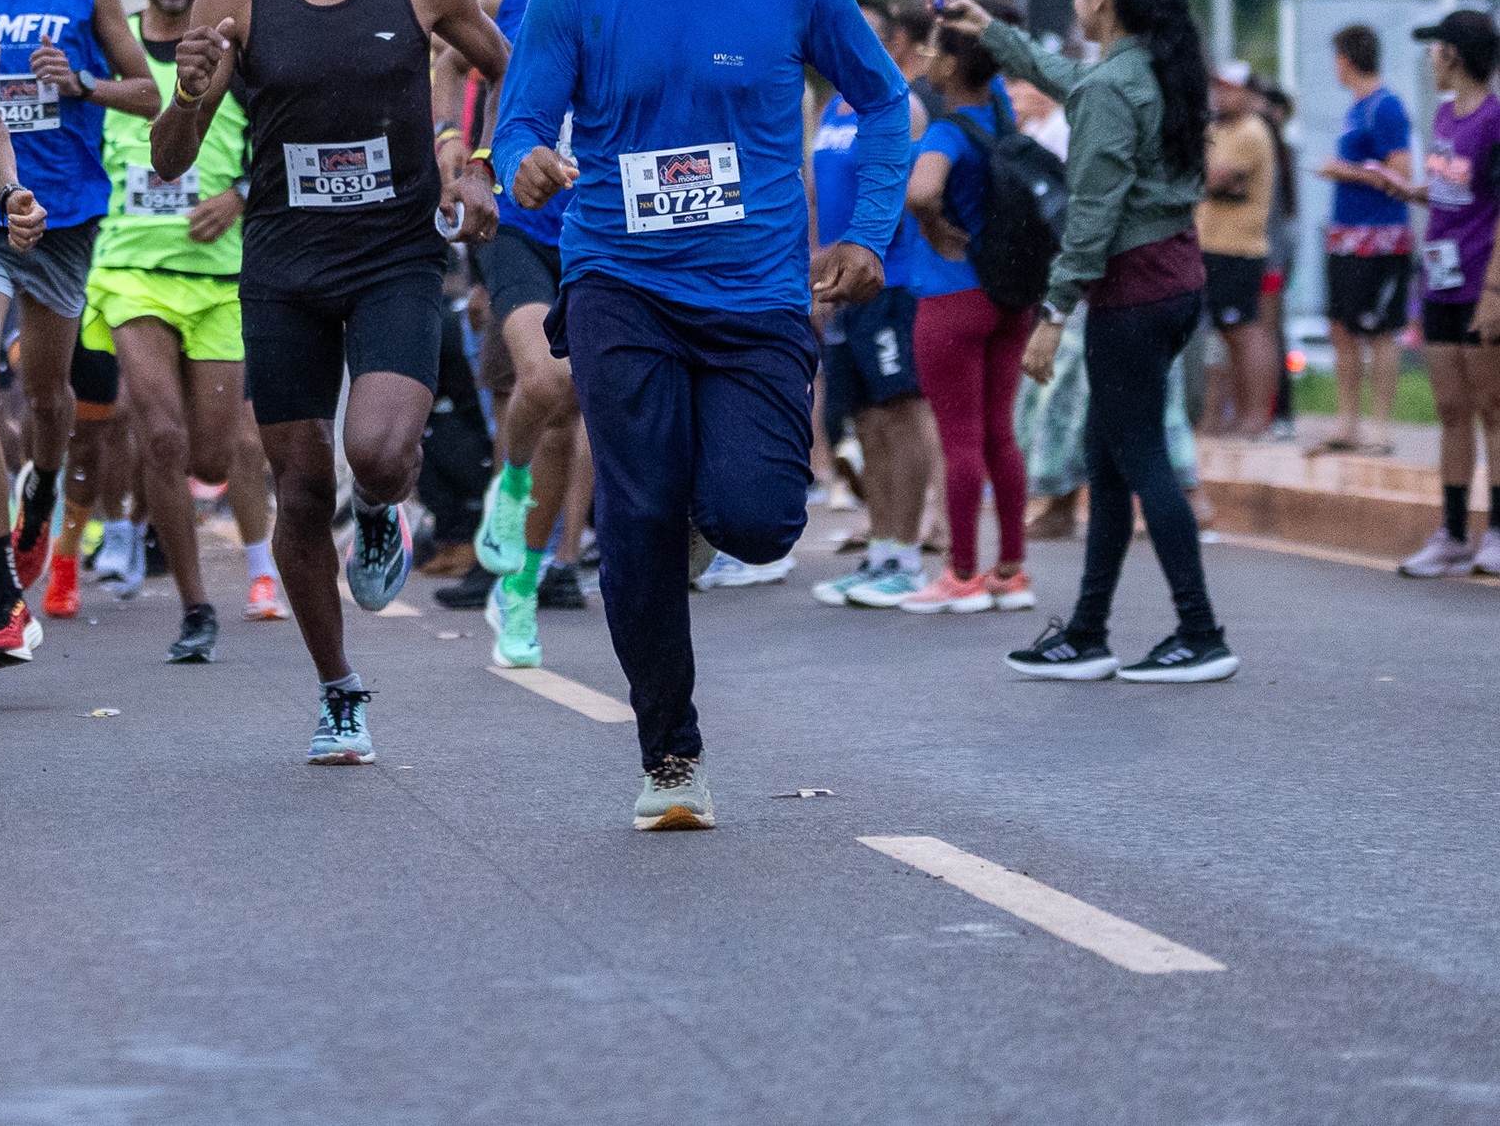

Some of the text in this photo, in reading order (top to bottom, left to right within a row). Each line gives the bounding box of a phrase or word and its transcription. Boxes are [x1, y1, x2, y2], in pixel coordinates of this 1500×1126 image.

[315, 174, 377, 194] 0630
[678, 173, 711, 183] moderna
[639, 186, 740, 214] 7KM 0722 7KM
